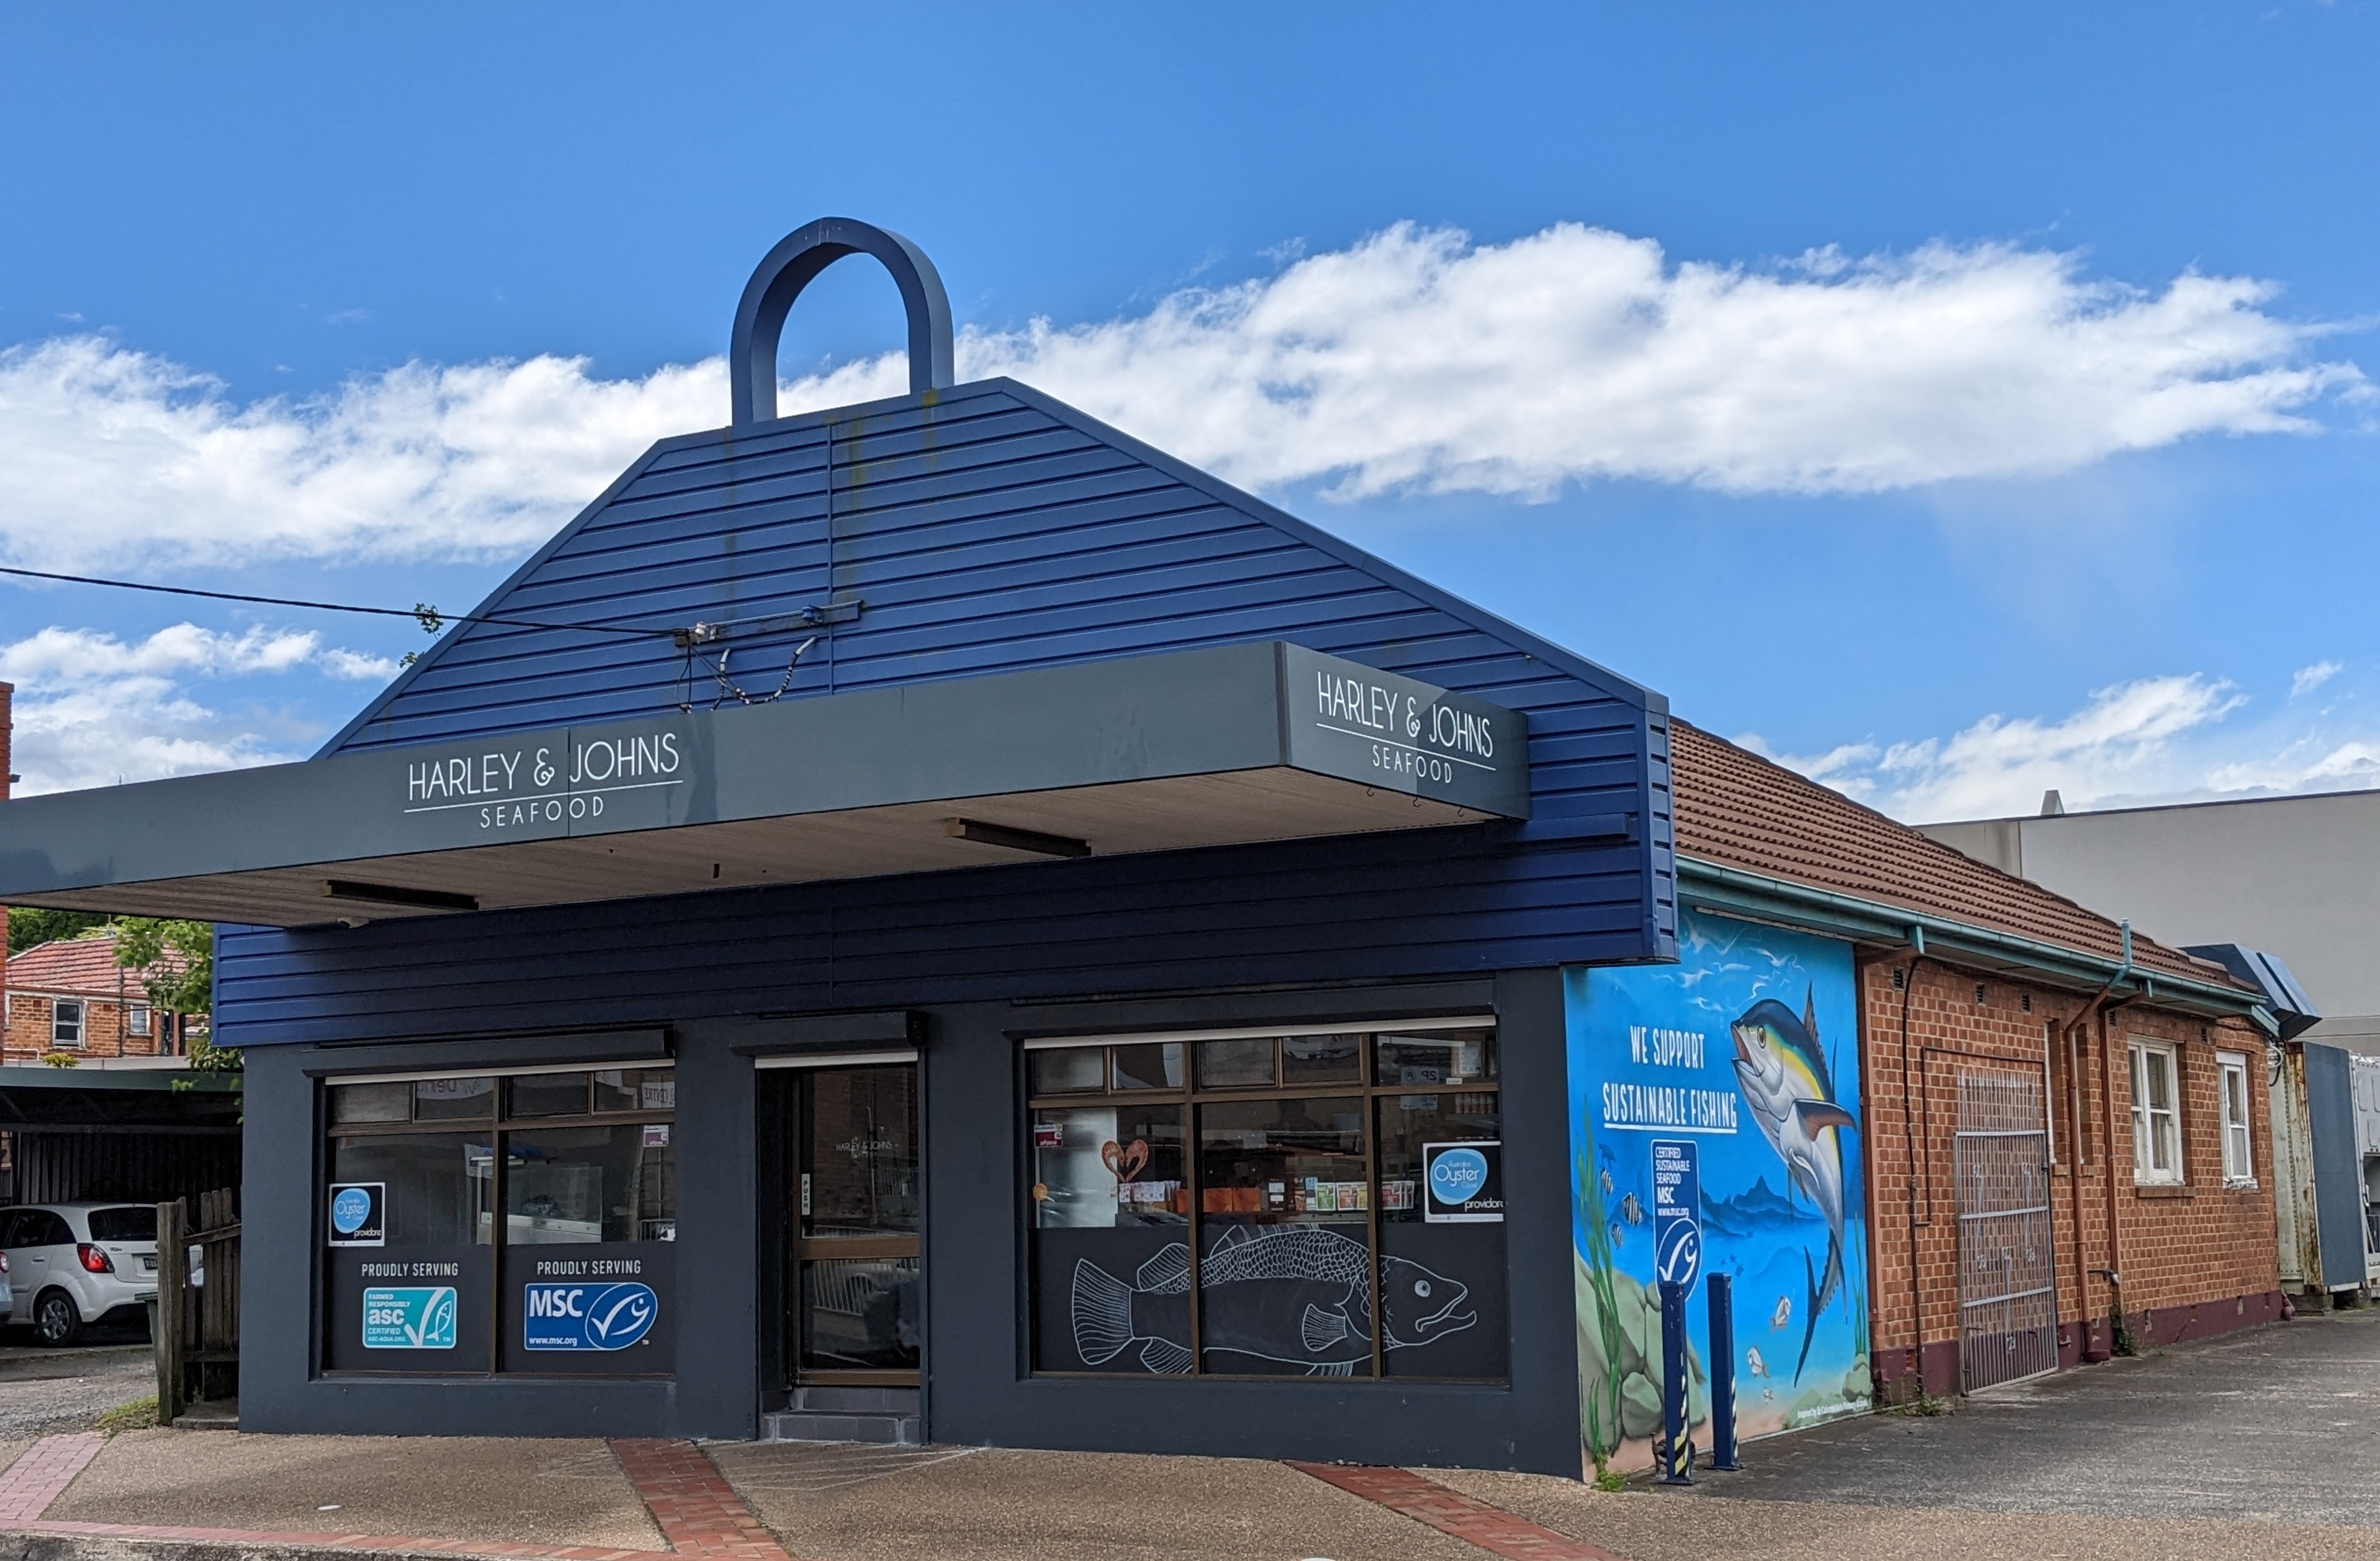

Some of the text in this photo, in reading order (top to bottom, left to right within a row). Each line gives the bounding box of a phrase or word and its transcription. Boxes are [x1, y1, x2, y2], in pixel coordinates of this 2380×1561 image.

[1317, 671, 1493, 758] HARLEY & JOHNS
[409, 733, 679, 801] HARLEY & JOHNS
[1372, 745, 1452, 783] SEAFOOD
[480, 796, 603, 828] SEAFOOD
[1630, 1025, 1704, 1069] WE SUPPORT
[1603, 1082, 1737, 1128] SUSTAINABLE FISHING
[836, 1141, 860, 1151] HARLEY
[1655, 1147, 1681, 1158] CERTIFIED
[1656, 1160, 1691, 1171] SUSTAINABLE
[1434, 1164, 1480, 1187] Oyster
[1656, 1173, 1681, 1184] SEAFOOD
[1658, 1186, 1675, 1204] MSC
[336, 1200, 365, 1219] Oyster
[361, 1262, 459, 1276] PROUDLY SERVING
[537, 1260, 642, 1275] PROUDLY SERVING
[529, 1289, 584, 1317] MSC
[368, 1308, 405, 1325] asc
[529, 1337, 577, 1347] www.msc.org
